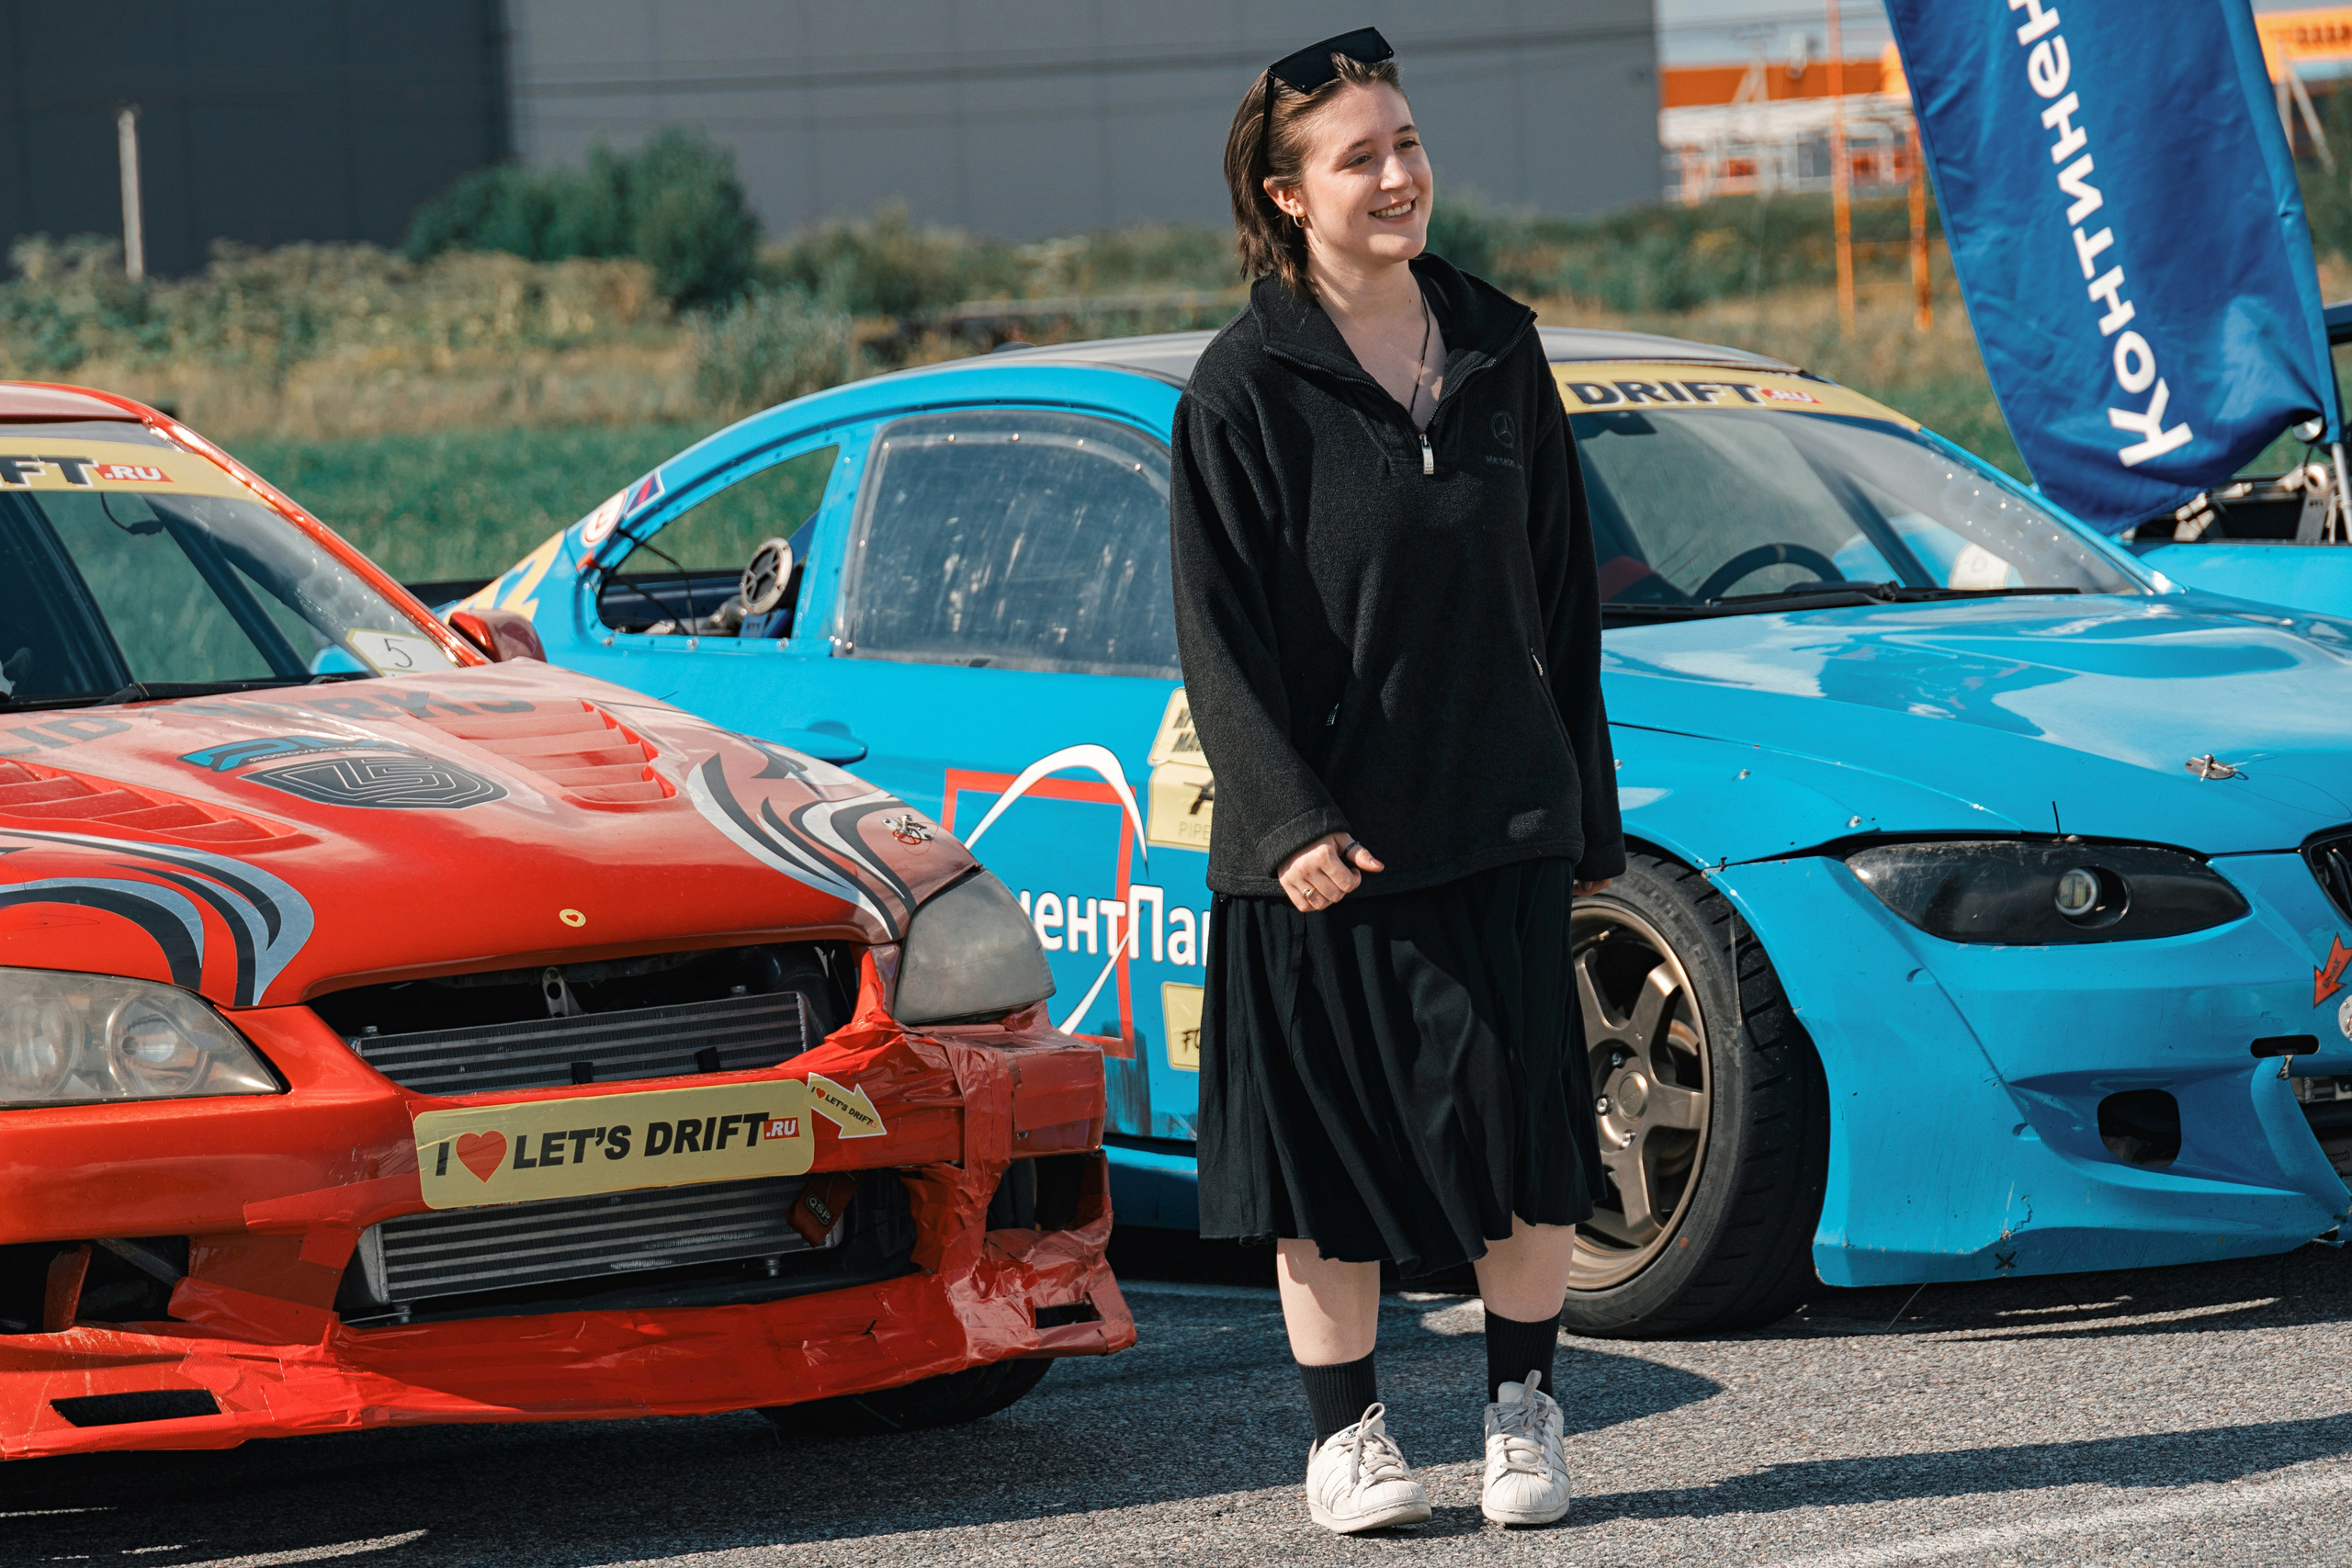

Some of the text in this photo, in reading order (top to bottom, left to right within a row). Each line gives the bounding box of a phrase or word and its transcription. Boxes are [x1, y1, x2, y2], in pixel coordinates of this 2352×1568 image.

[383, 637, 413, 669] 5
[825, 1094, 849, 1112] LET'S
[435, 1142, 450, 1177] I
[513, 1125, 632, 1169] LET'S
